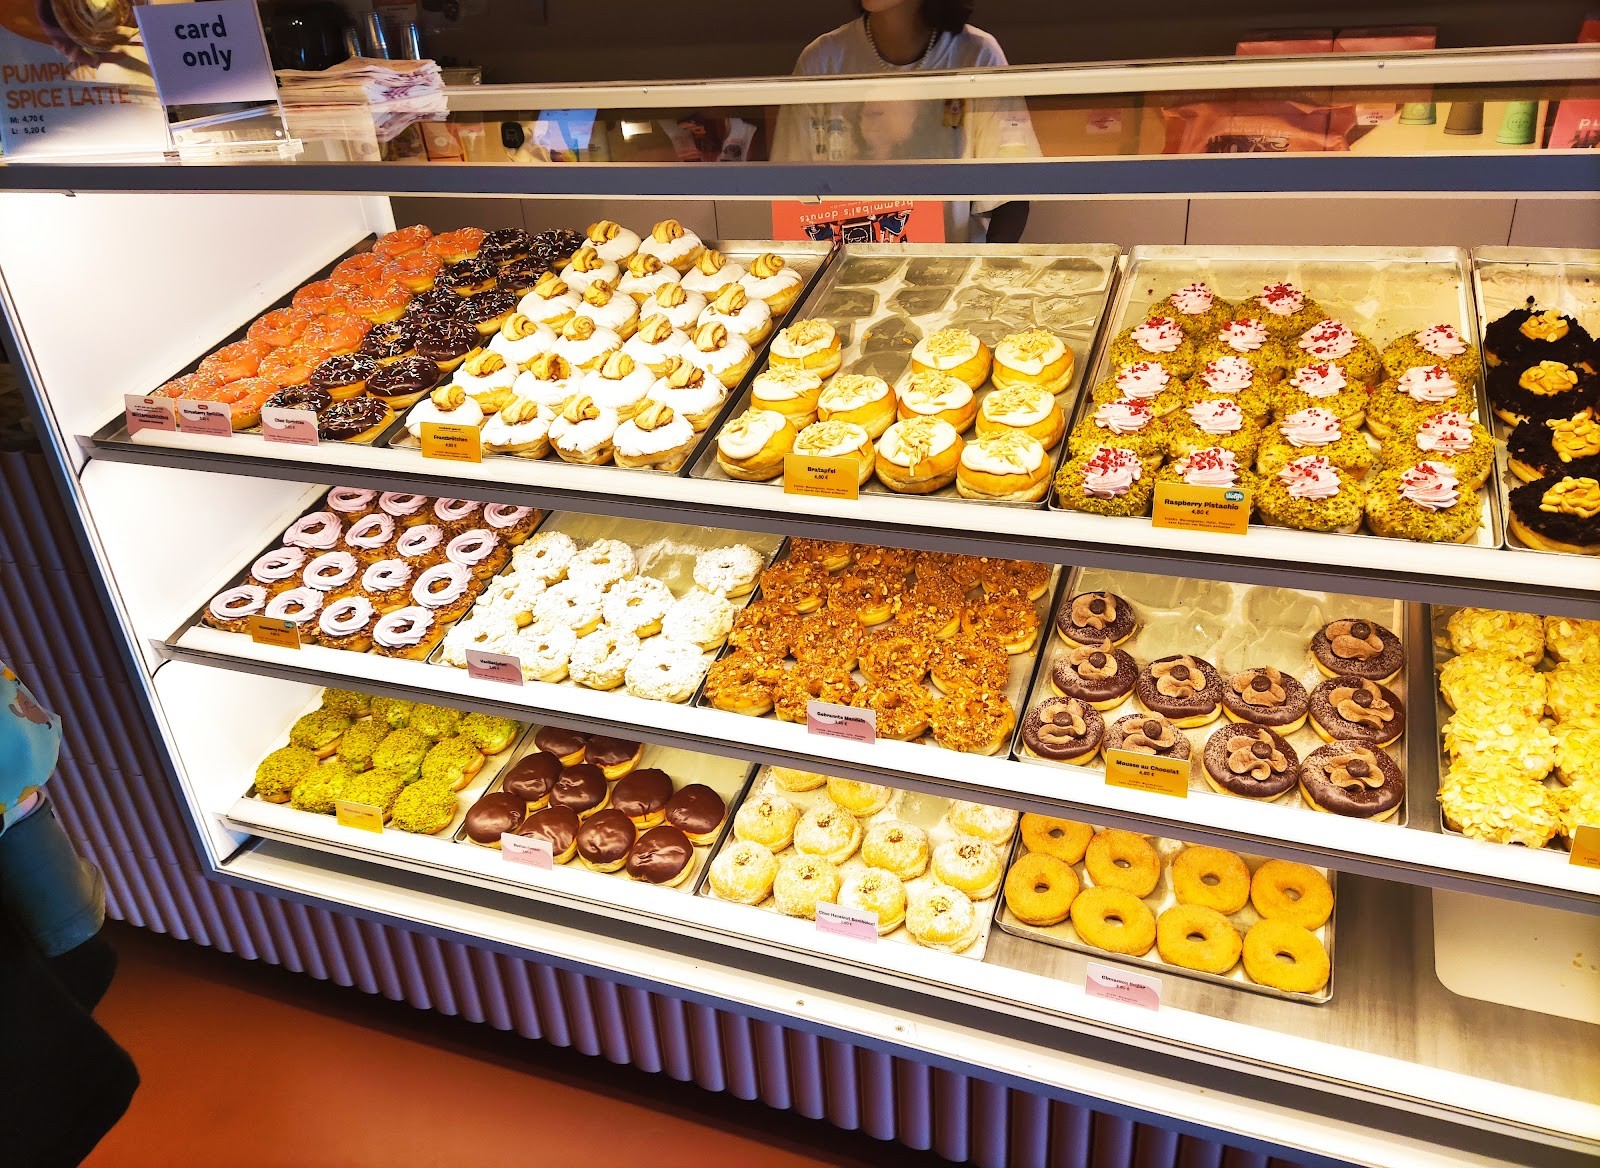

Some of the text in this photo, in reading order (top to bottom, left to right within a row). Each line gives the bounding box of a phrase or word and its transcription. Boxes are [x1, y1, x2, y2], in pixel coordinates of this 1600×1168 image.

[174, 14, 227, 40] card
[182, 42, 232, 71] only
[2, 62, 97, 84] PUMPKIN
[6, 85, 132, 110] SPICE LATTE
[39, 114, 45, 122] €
[24, 126, 39, 134] 5,20
[844, 200, 914, 217] brammibal's
[799, 210, 838, 223] donuts
[807, 466, 836, 474] Bratapfel
[1164, 498, 1239, 510] Raspberry Pistachio
[816, 711, 844, 720] Gebrannte
[1116, 760, 1140, 768] Mousse
[1150, 765, 1180, 775] Chocolat
[1101, 975, 1129, 986] Cinnamon
